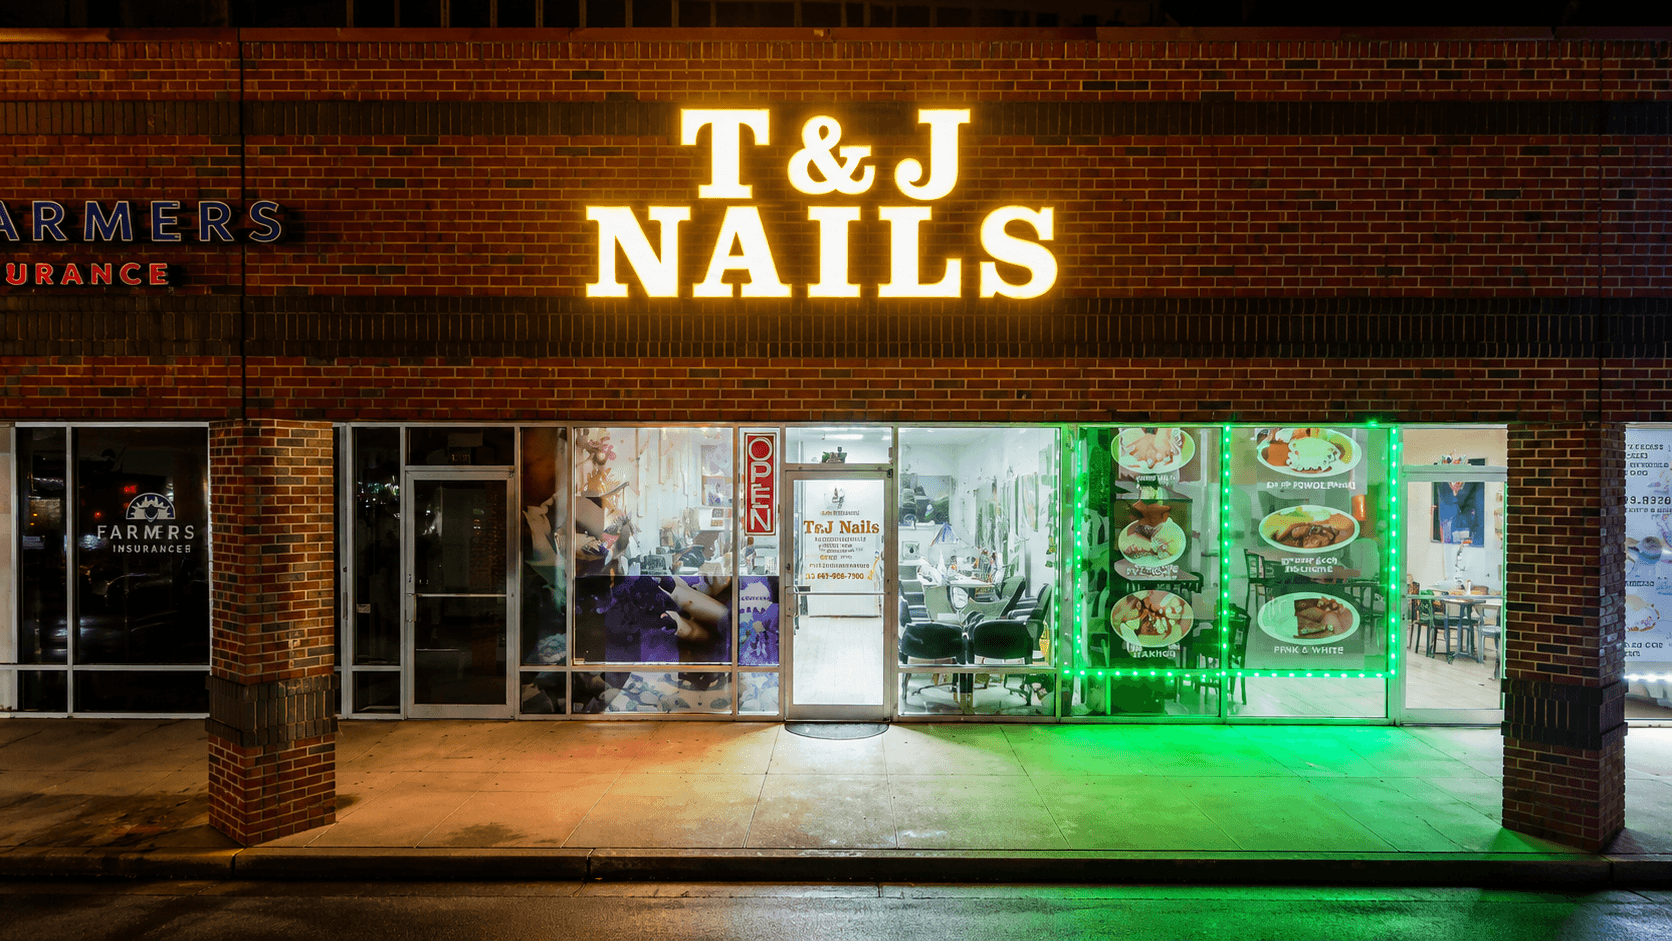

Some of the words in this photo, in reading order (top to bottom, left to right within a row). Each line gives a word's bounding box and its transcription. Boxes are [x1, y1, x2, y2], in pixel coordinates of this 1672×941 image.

[585, 205, 1058, 299] NAILS
[5, 262, 169, 285] URANCE
[748, 437, 772, 531] OPEN
[97, 524, 195, 540] FARMERS
[839, 520, 880, 534] Nails
[1311, 646, 1344, 655] WHITE
